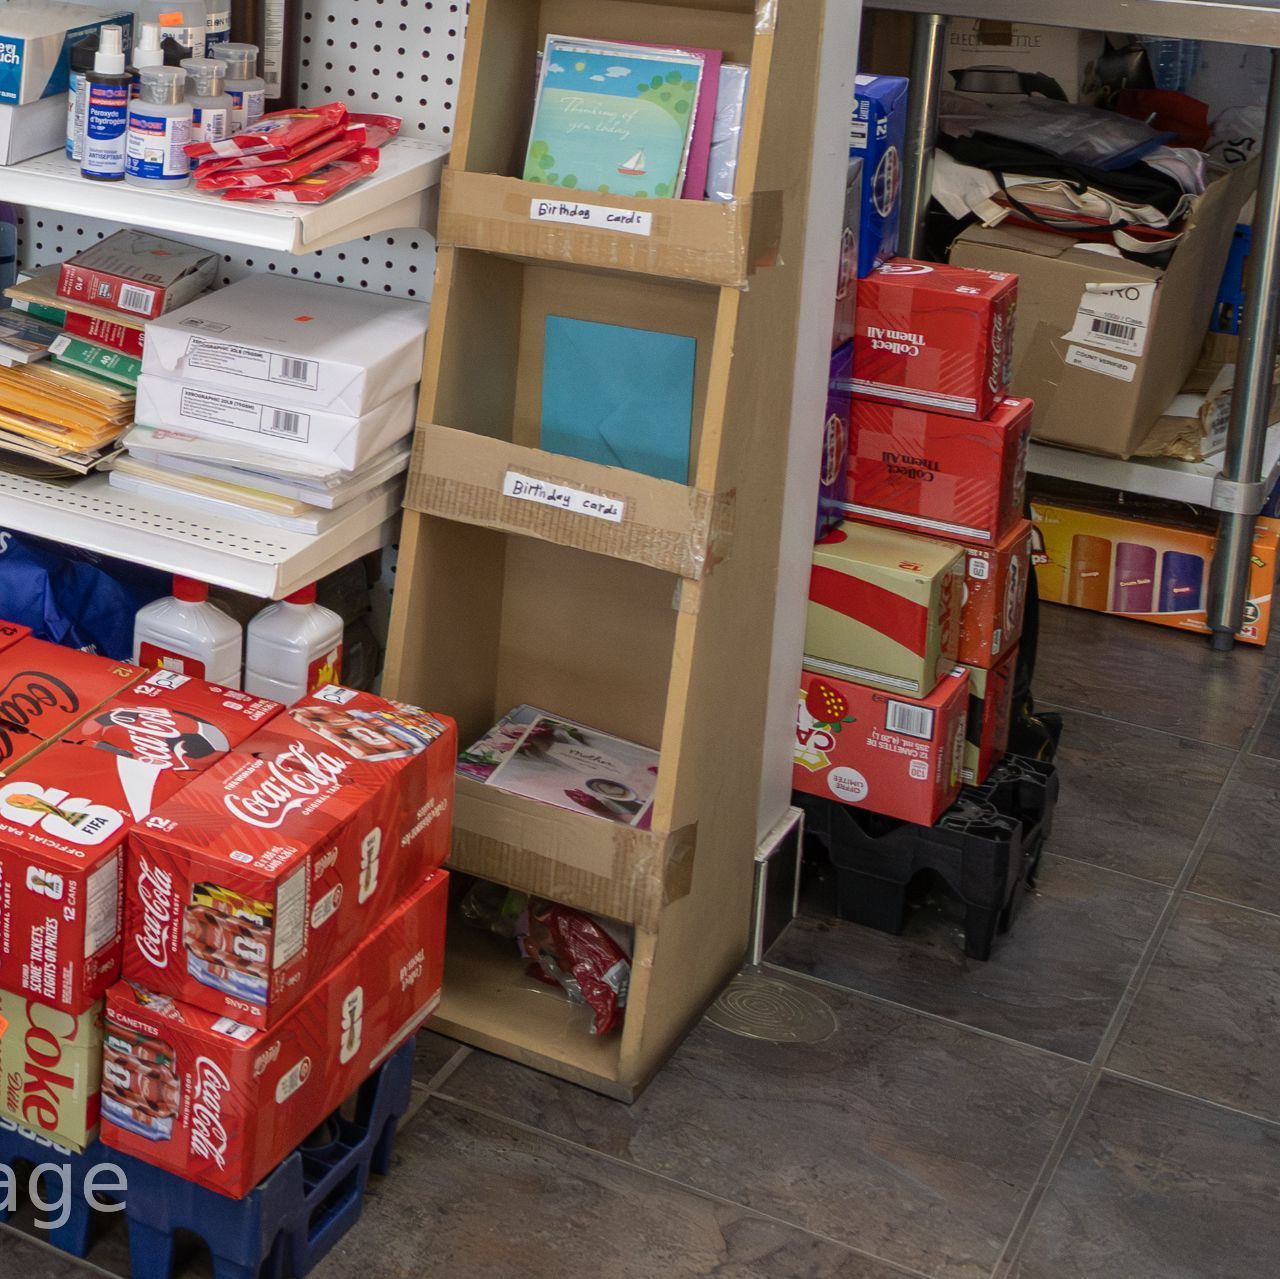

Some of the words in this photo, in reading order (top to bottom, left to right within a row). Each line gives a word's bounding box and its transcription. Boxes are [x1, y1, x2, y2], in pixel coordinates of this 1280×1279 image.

[538, 202, 591, 221] Birthday
[607, 211, 642, 225] cards
[512, 479, 571, 507] Birthday
[582, 496, 618, 517] cards
[223, 740, 346, 828] Coca-Cola
[83, 816, 108, 837] FIFA
[23, 998, 76, 1132] Coke
[190, 1057, 231, 1170] Coca-Cola
